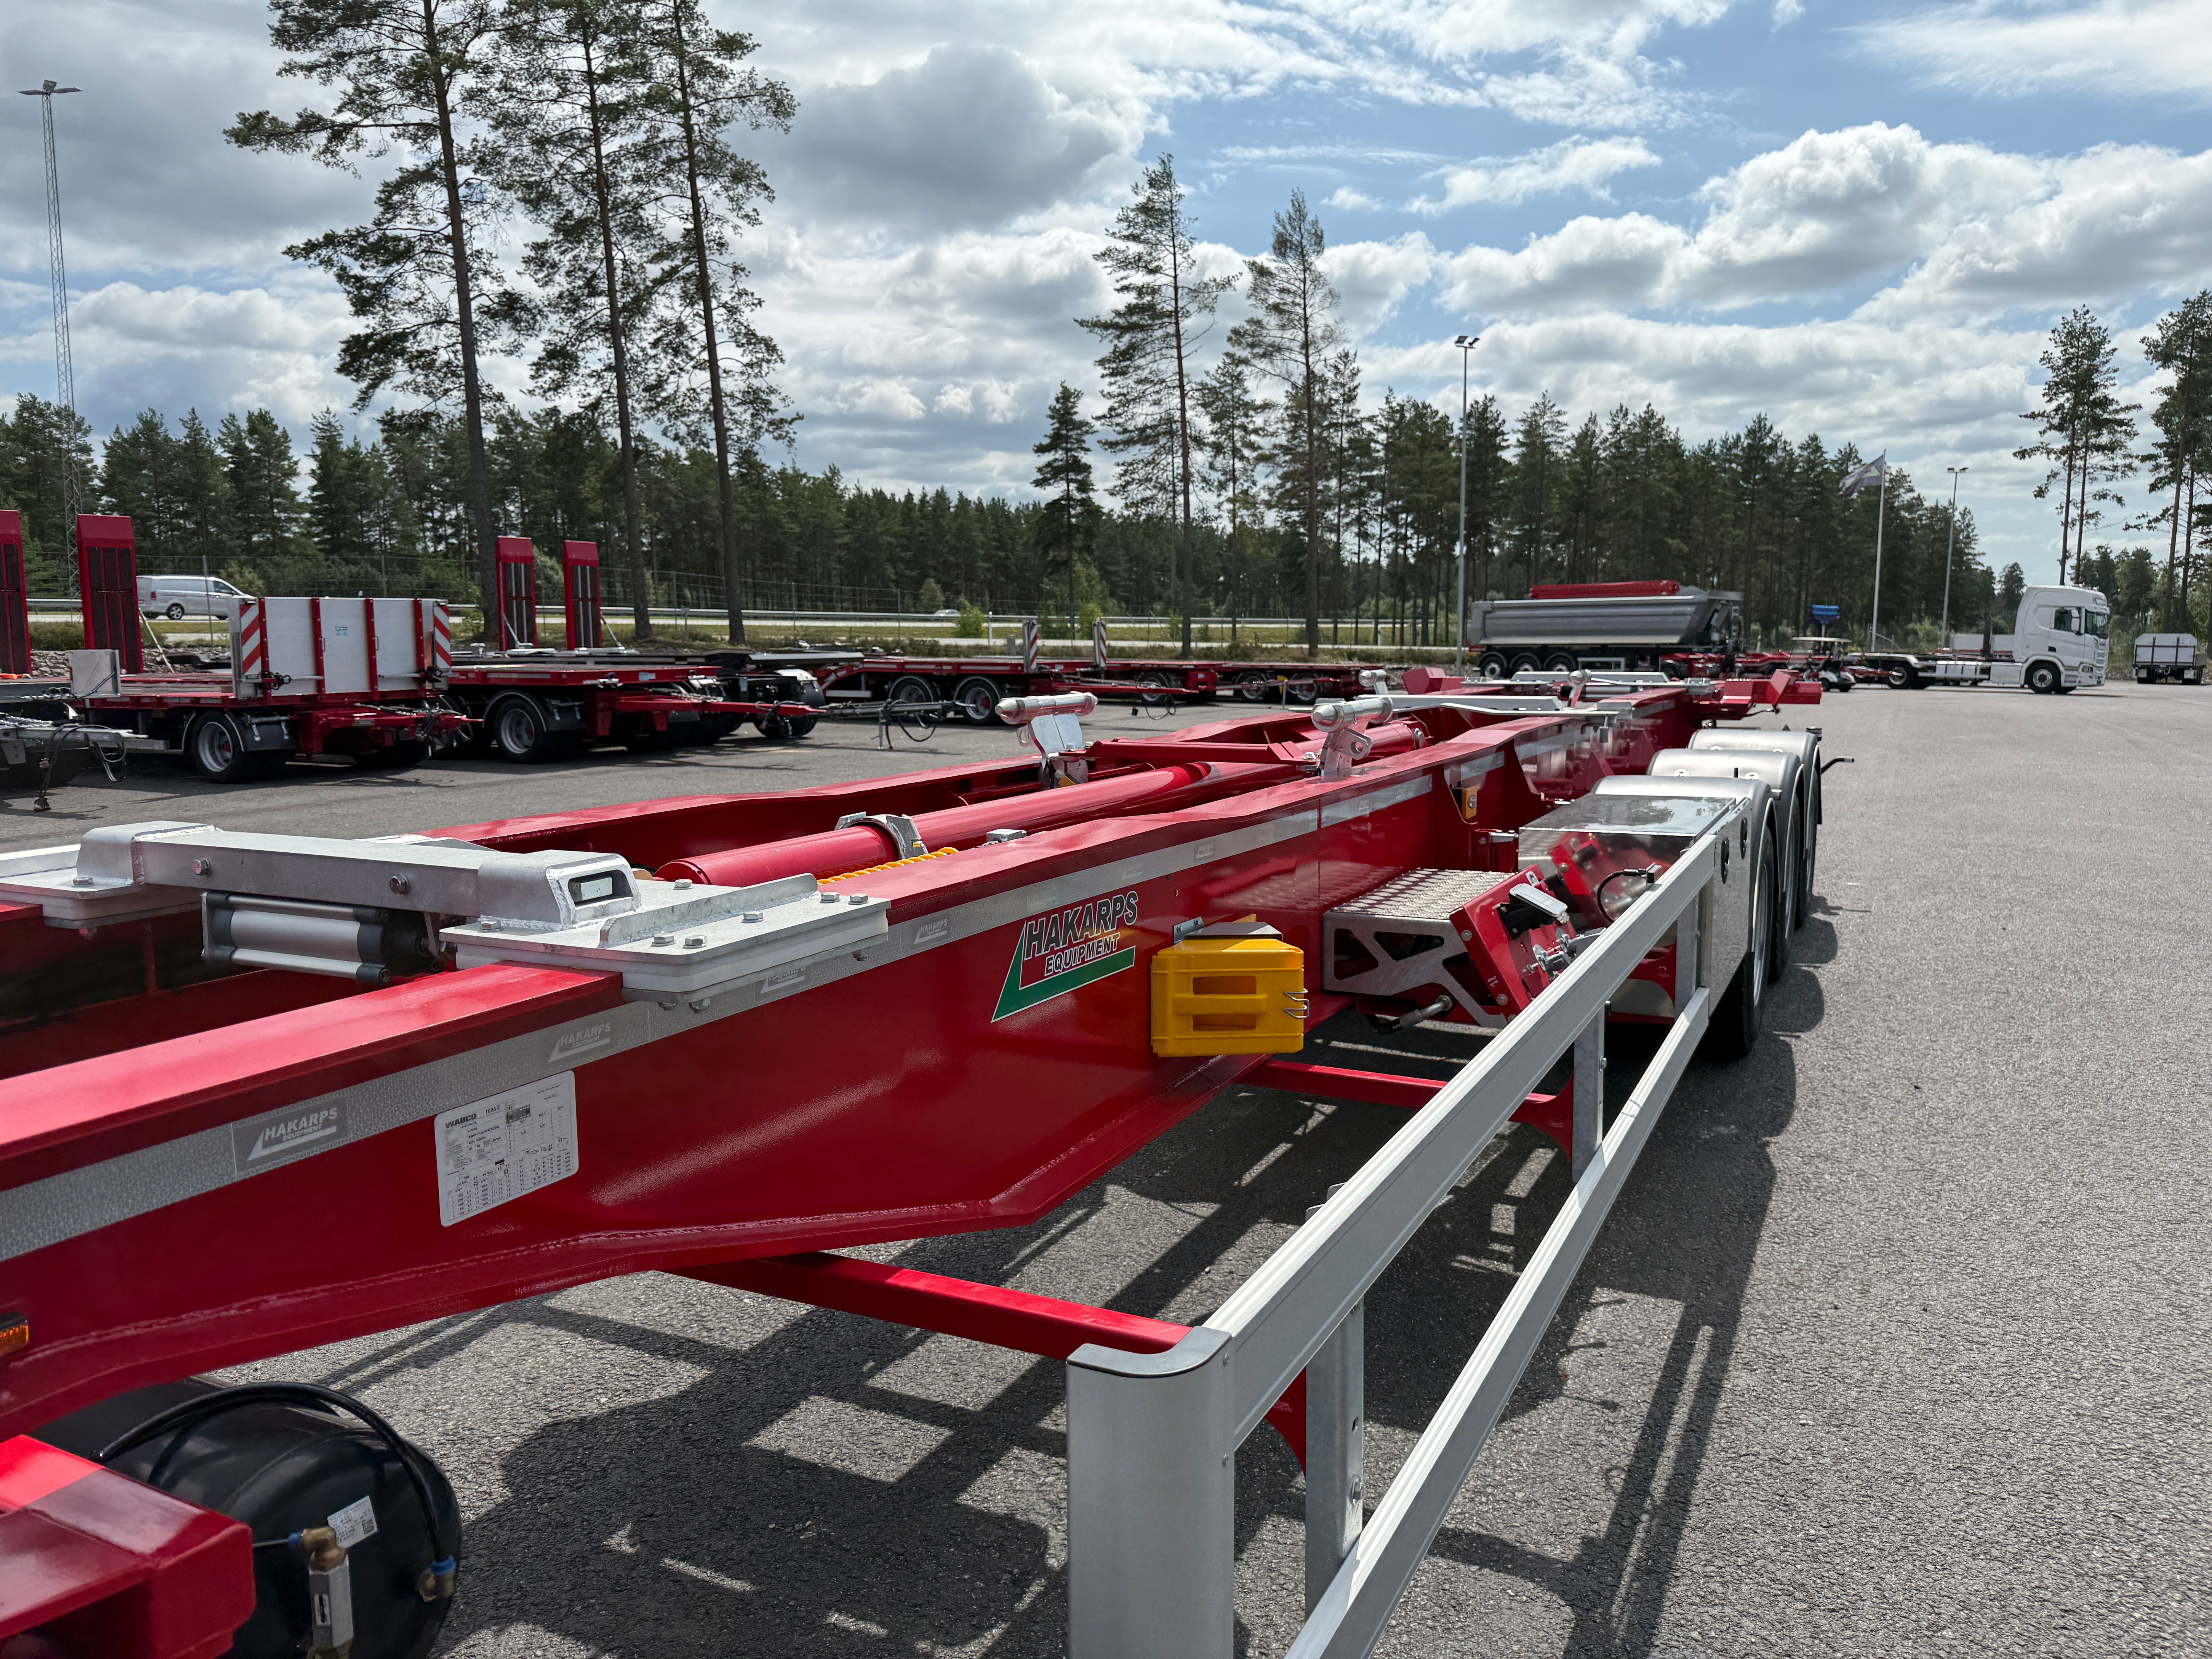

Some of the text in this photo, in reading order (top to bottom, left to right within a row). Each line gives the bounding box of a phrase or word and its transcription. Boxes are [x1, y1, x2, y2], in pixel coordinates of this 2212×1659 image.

[1024, 891, 1138, 960] HAKARPS
[1044, 932, 1120, 976] EQUIPMENT
[560, 1022, 611, 1046] HAKARPS
[264, 1108, 337, 1140] HAKARPS
[445, 1113, 477, 1128] WABCO
